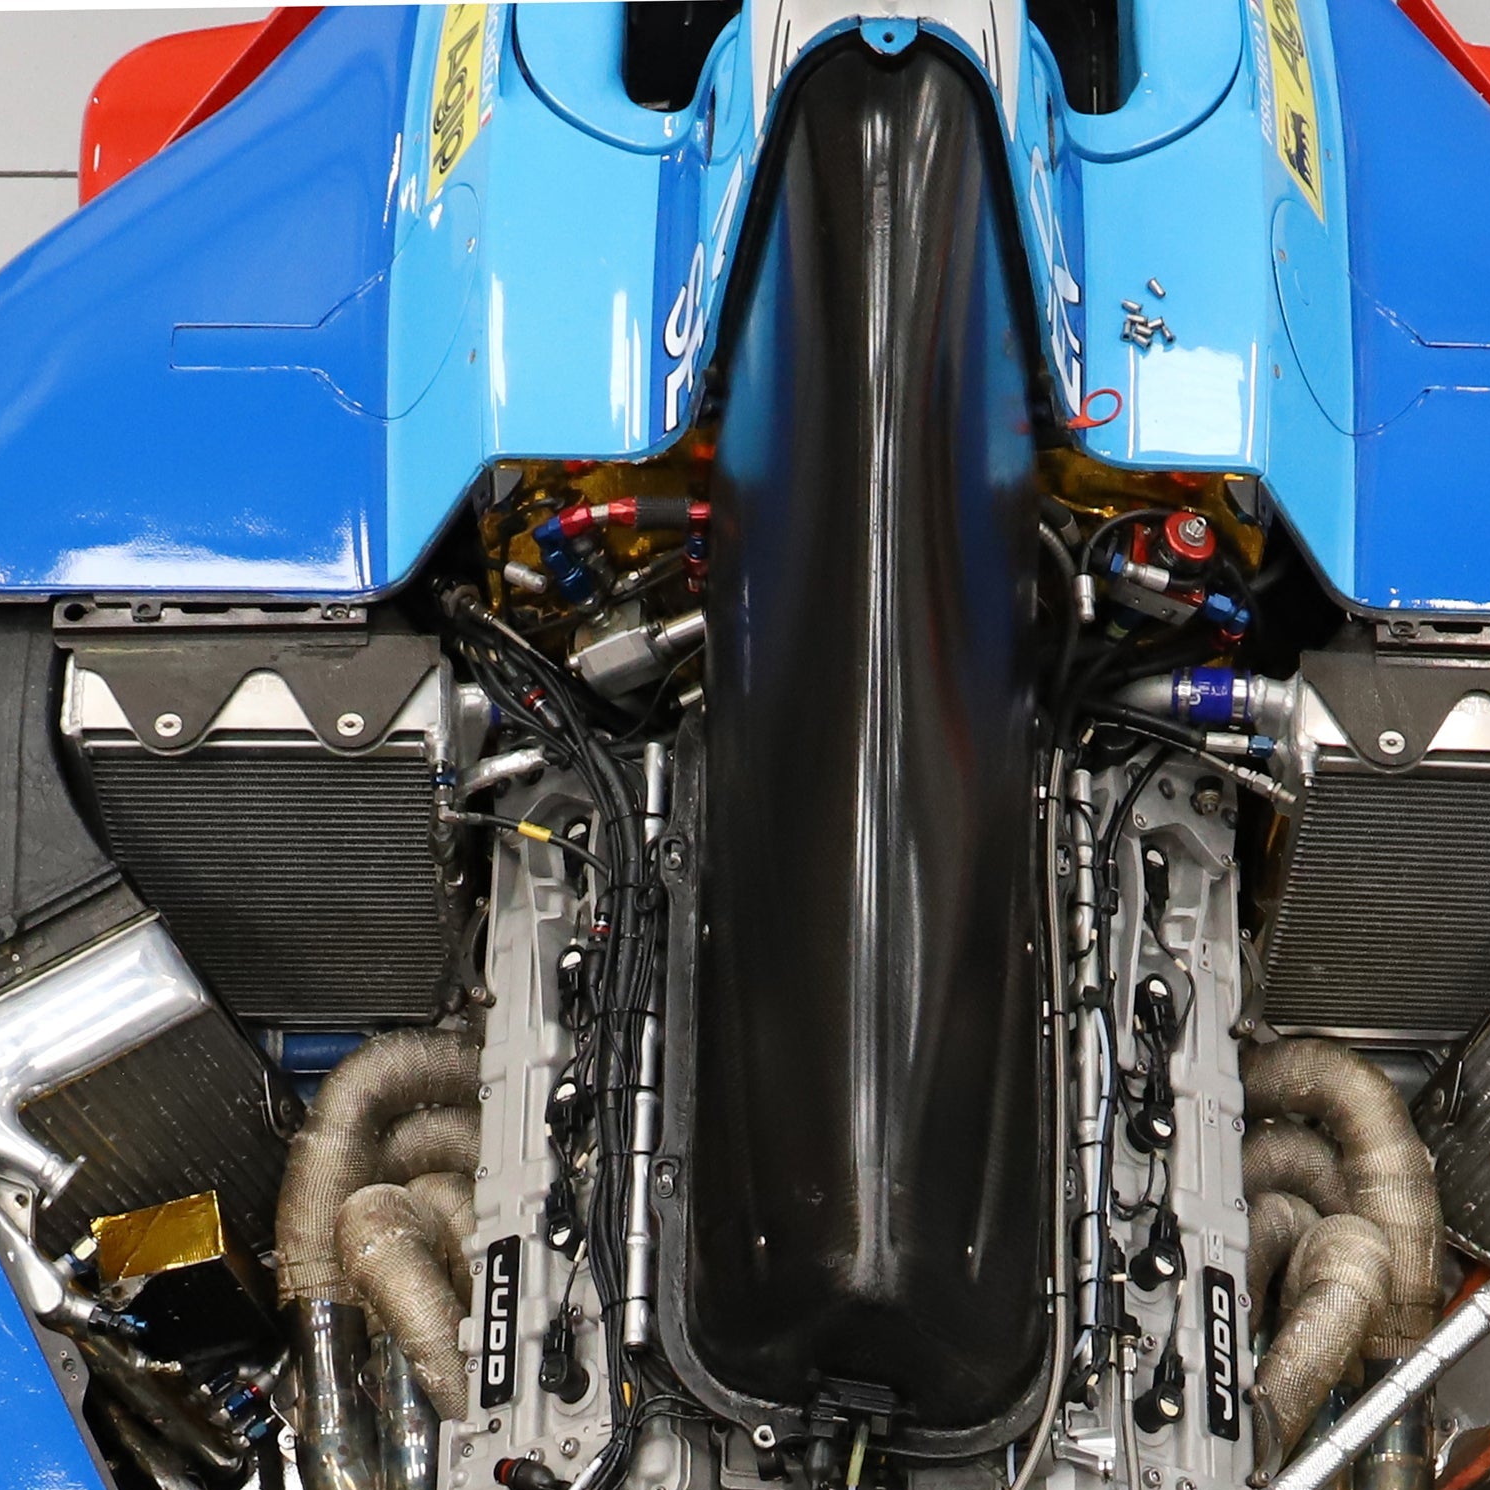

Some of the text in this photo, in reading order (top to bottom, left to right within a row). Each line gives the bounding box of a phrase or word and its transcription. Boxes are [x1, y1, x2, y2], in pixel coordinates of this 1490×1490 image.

[432, 20, 480, 175] Agip
[1253, 20, 1273, 145] FISICHELLA
[488, 1254, 510, 1385] JUDD
[1211, 1285, 1233, 1421] JUDD
